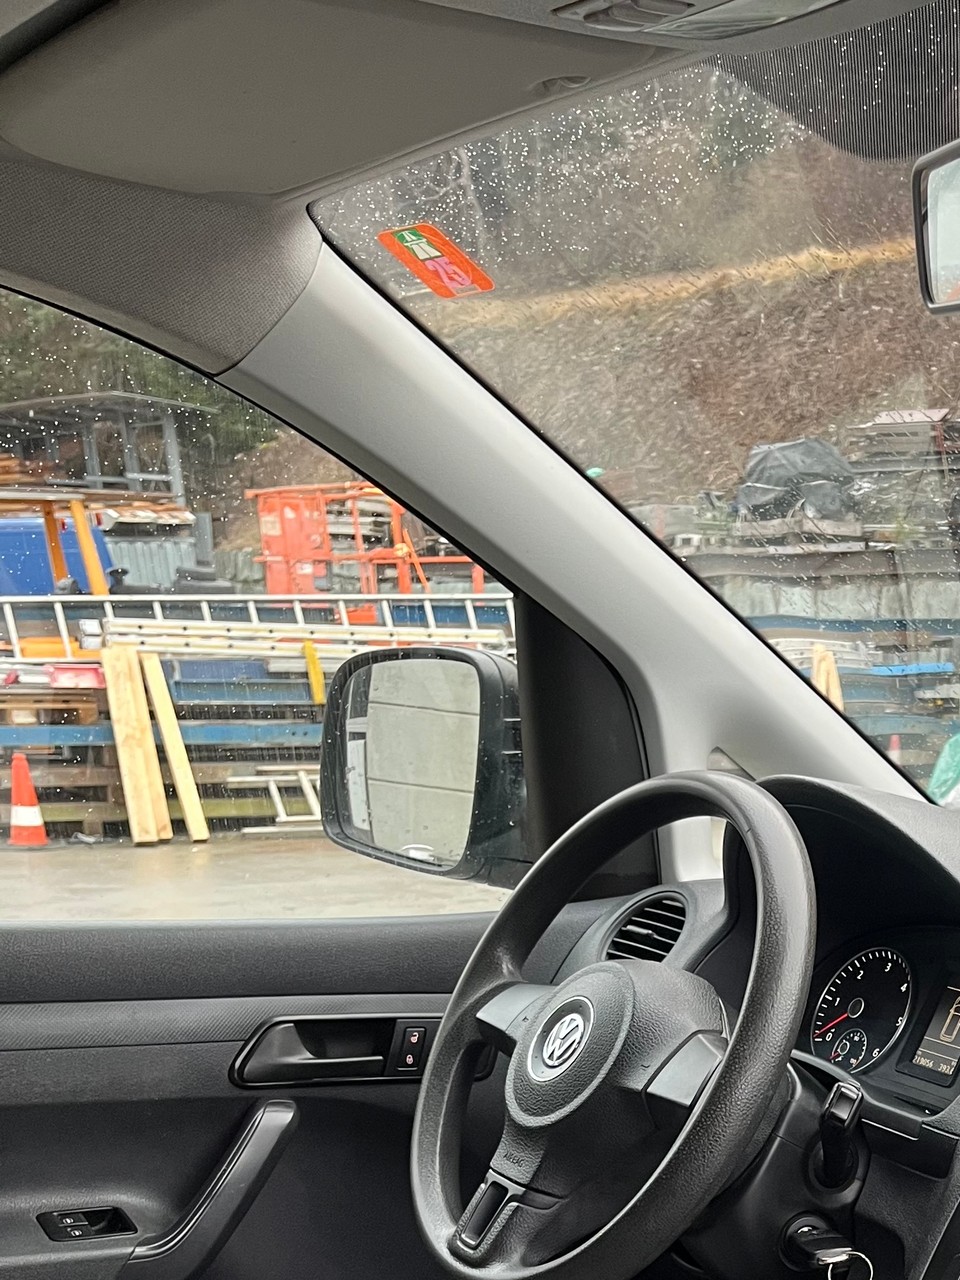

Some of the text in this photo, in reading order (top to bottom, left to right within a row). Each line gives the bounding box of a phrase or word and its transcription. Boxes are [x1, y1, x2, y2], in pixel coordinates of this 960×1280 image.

[885, 962, 892, 972] 3
[857, 970, 864, 980] 2
[900, 983, 908, 992] 4
[834, 997, 841, 1006] 1
[896, 1016, 904, 1026] 5
[825, 1032, 833, 1041] 0
[872, 1048, 880, 1057] 6
